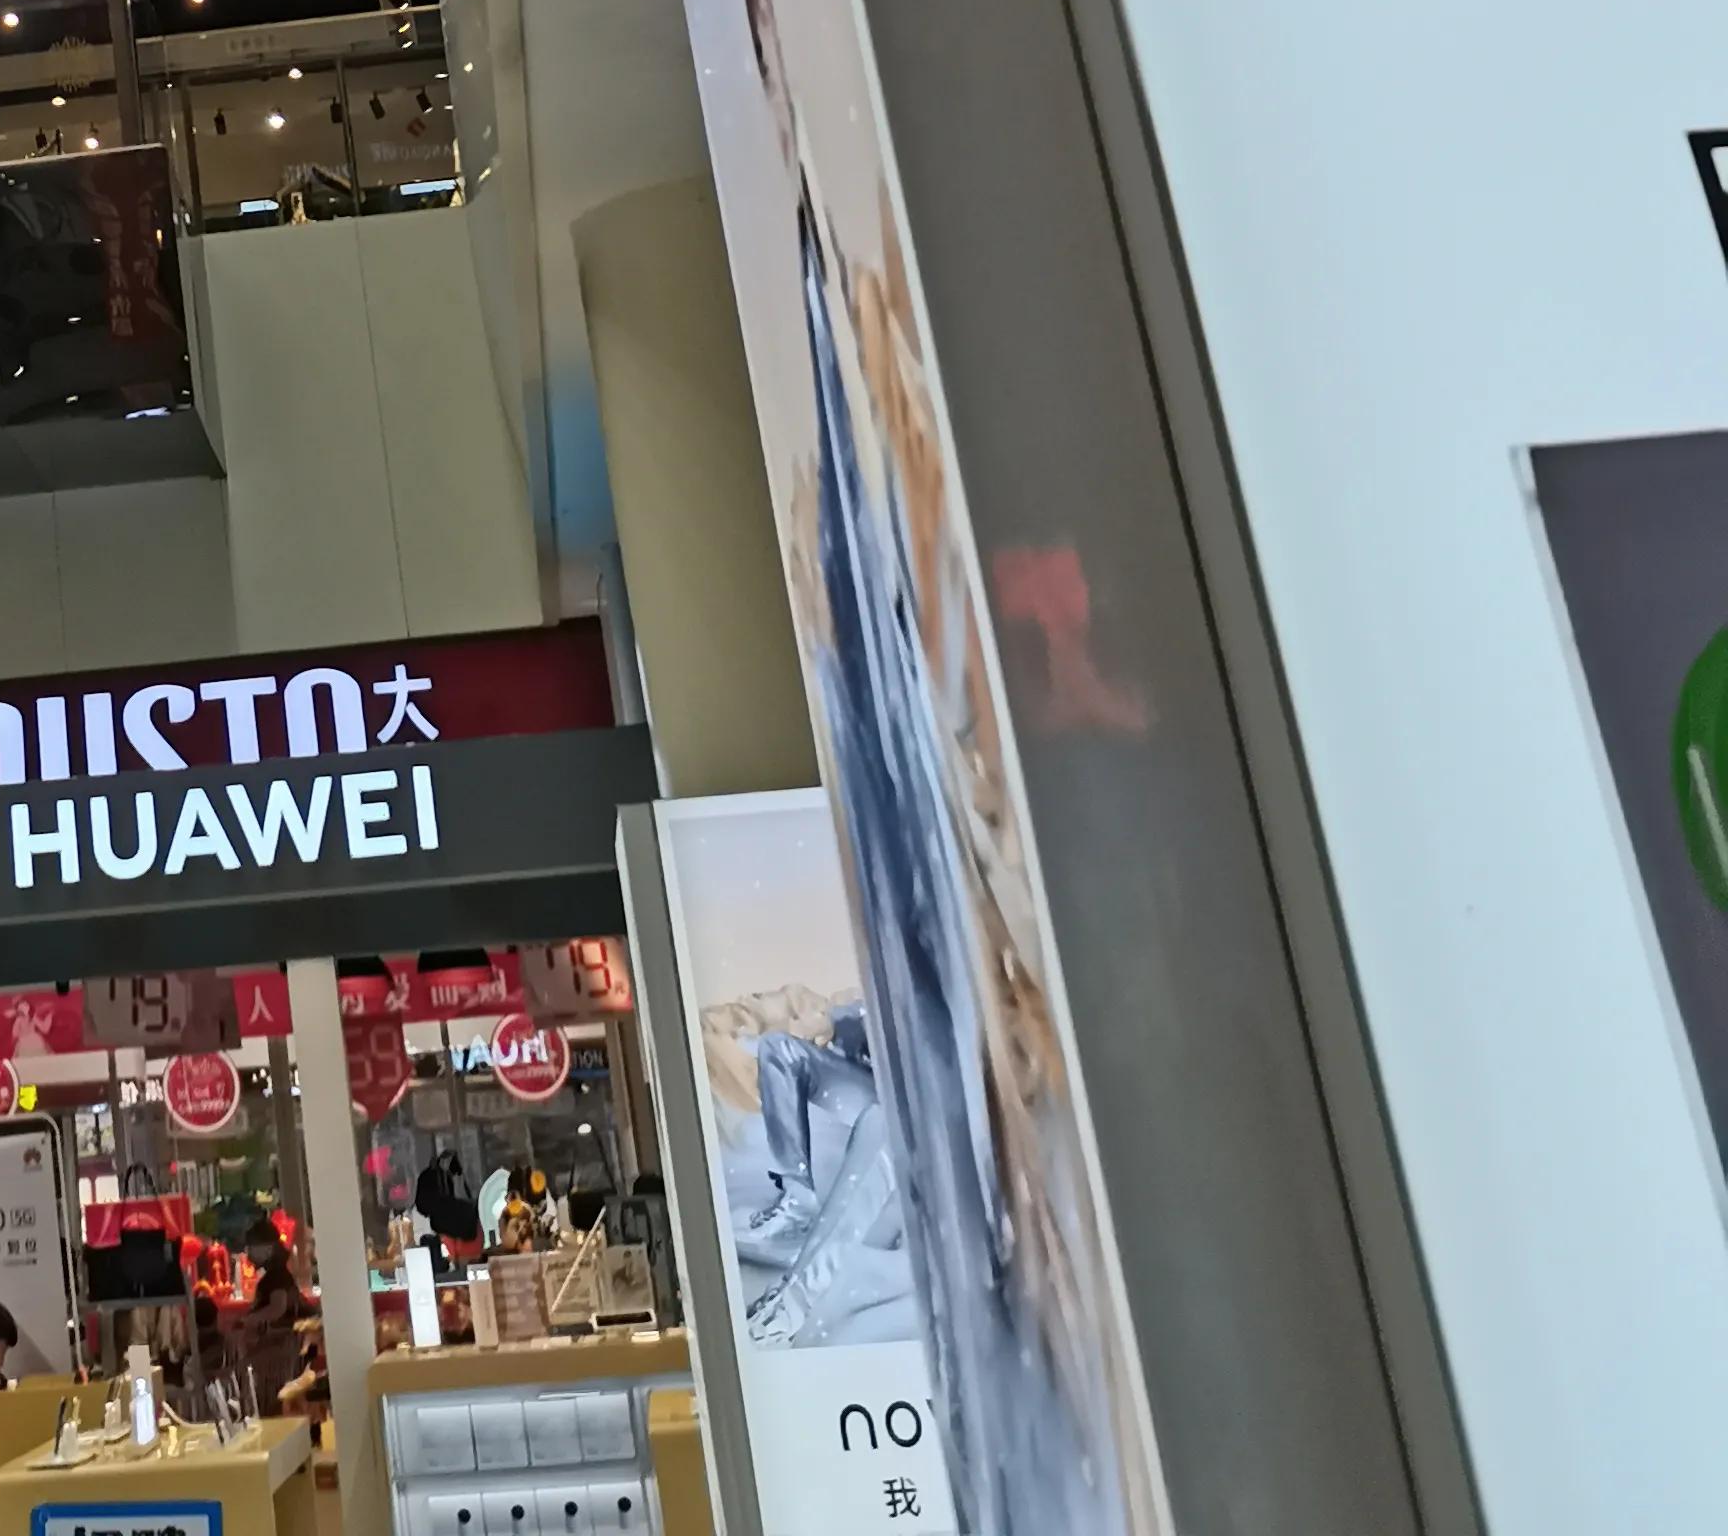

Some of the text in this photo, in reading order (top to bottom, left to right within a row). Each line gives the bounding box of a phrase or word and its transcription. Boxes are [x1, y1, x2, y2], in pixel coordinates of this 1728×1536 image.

[9, 764, 440, 889] HUAWEI
[840, 1400, 934, 1452] no
[882, 1476, 922, 1519] 我
